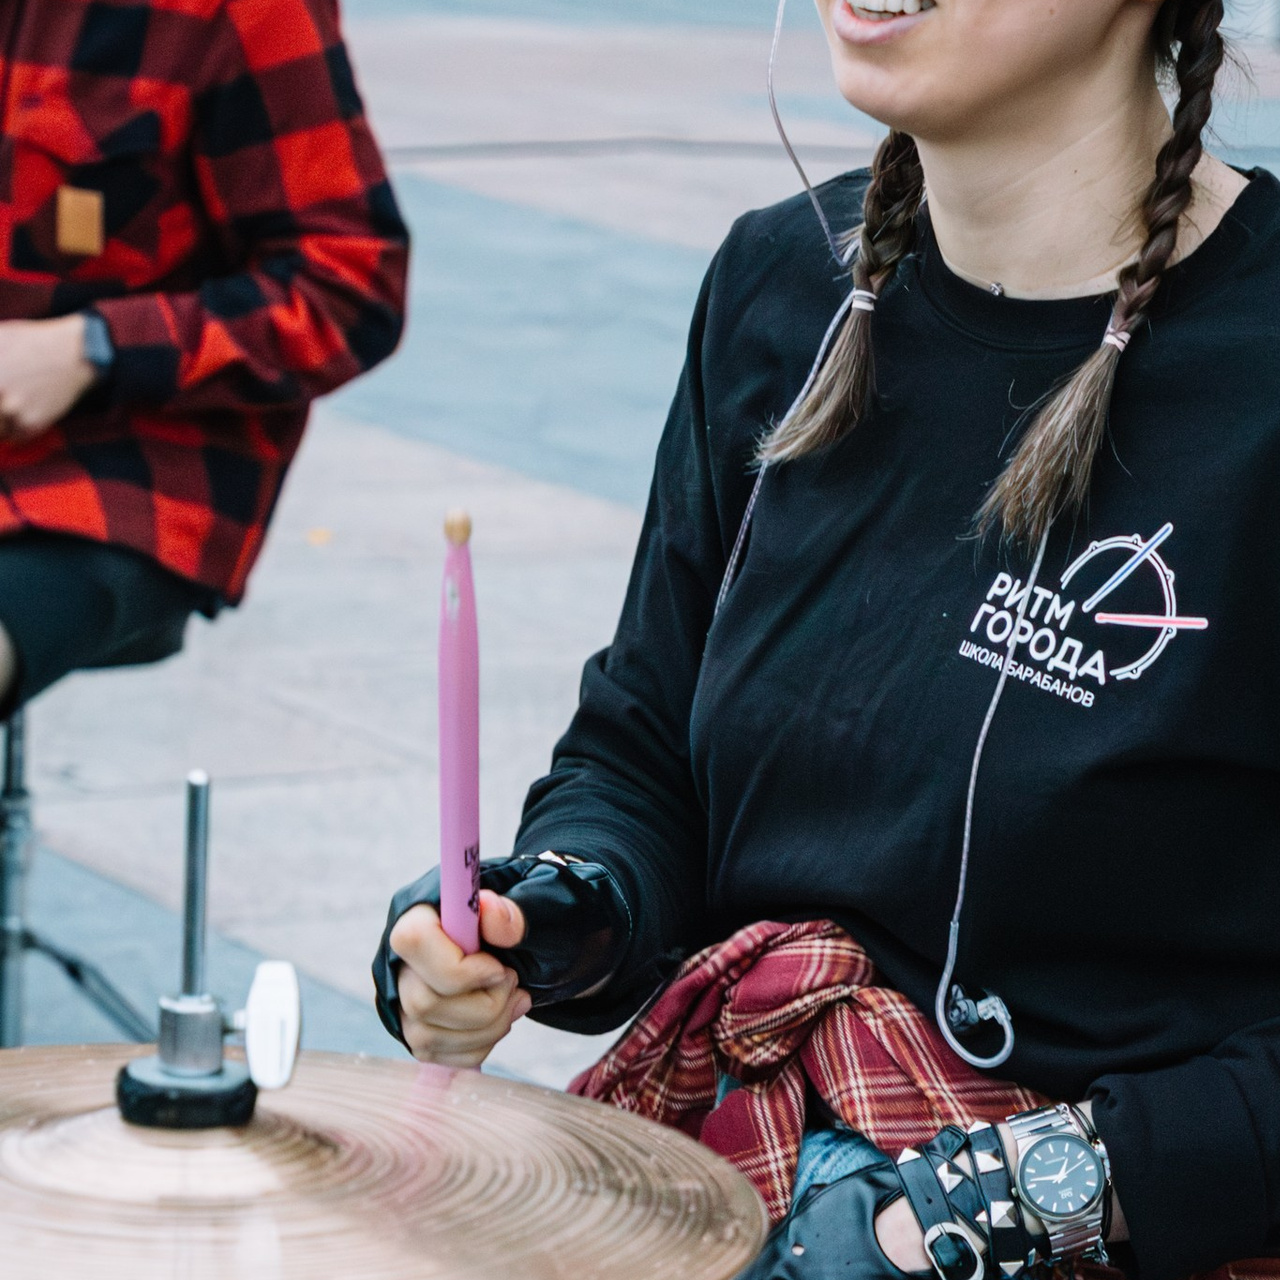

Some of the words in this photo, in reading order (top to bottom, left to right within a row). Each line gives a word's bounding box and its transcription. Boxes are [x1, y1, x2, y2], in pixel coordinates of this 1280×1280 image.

[986, 572, 1076, 631] РИТМ
[958, 639, 1005, 671] ШКОЛА
[970, 602, 1106, 686] ГОРОДА
[1005, 659, 1096, 708] БАРАБАНОВ
